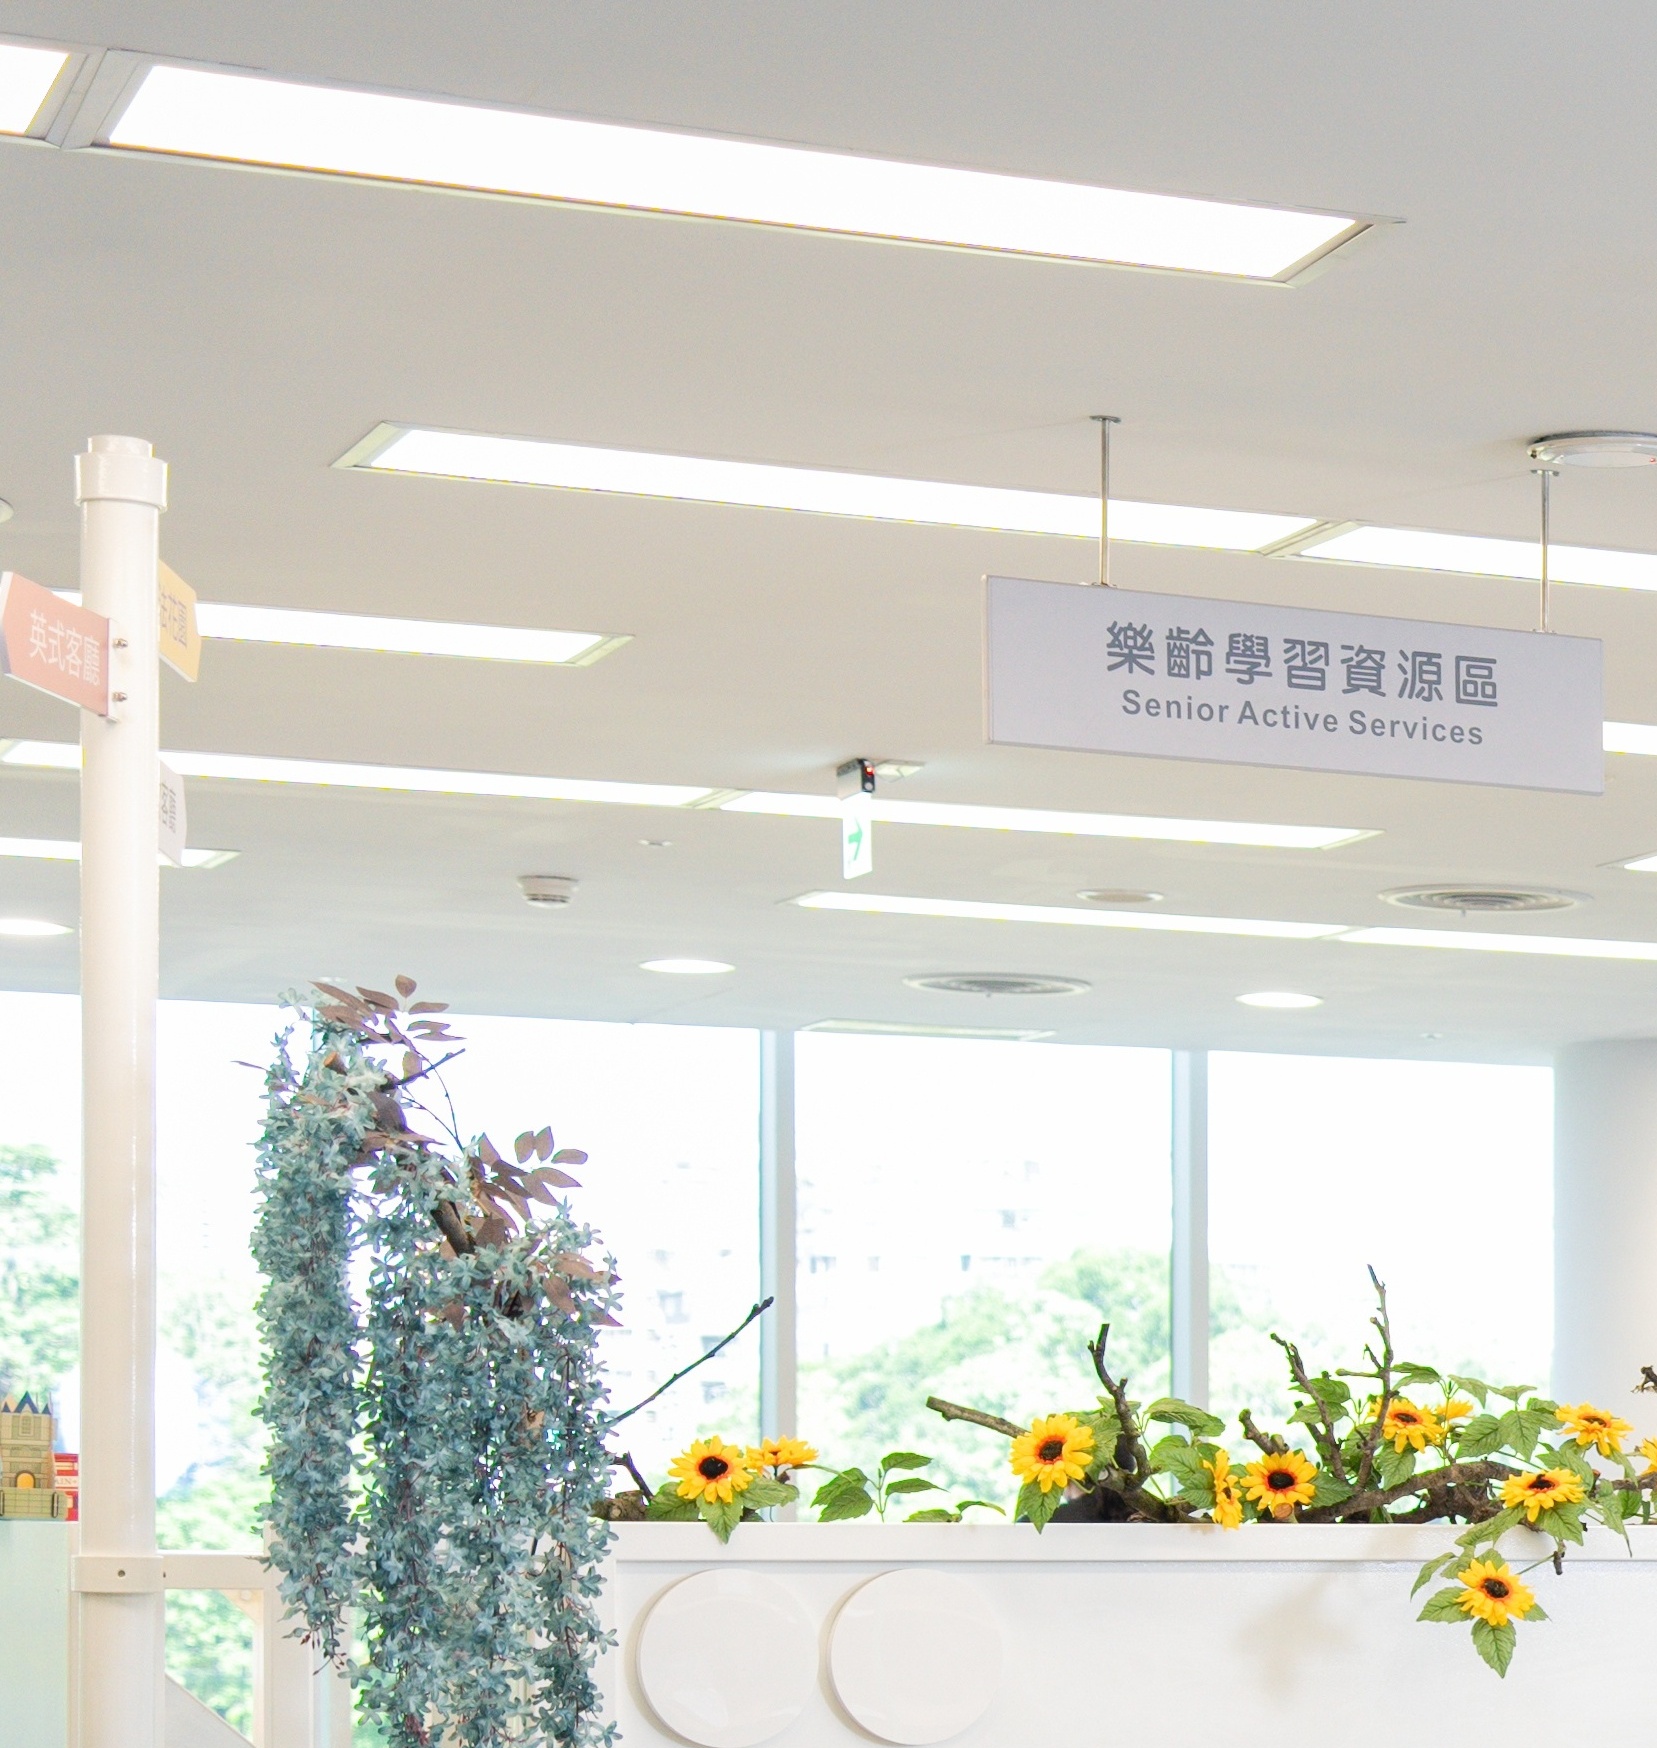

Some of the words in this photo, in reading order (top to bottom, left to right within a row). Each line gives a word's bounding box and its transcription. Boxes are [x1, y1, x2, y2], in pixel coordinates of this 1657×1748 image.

[29, 608, 101, 686] 英式客廳
[1106, 620, 1499, 708] 樂齡學習資源區
[1122, 689, 1229, 723] Senior
[1237, 699, 1339, 734] Active
[1349, 709, 1484, 746] Services
